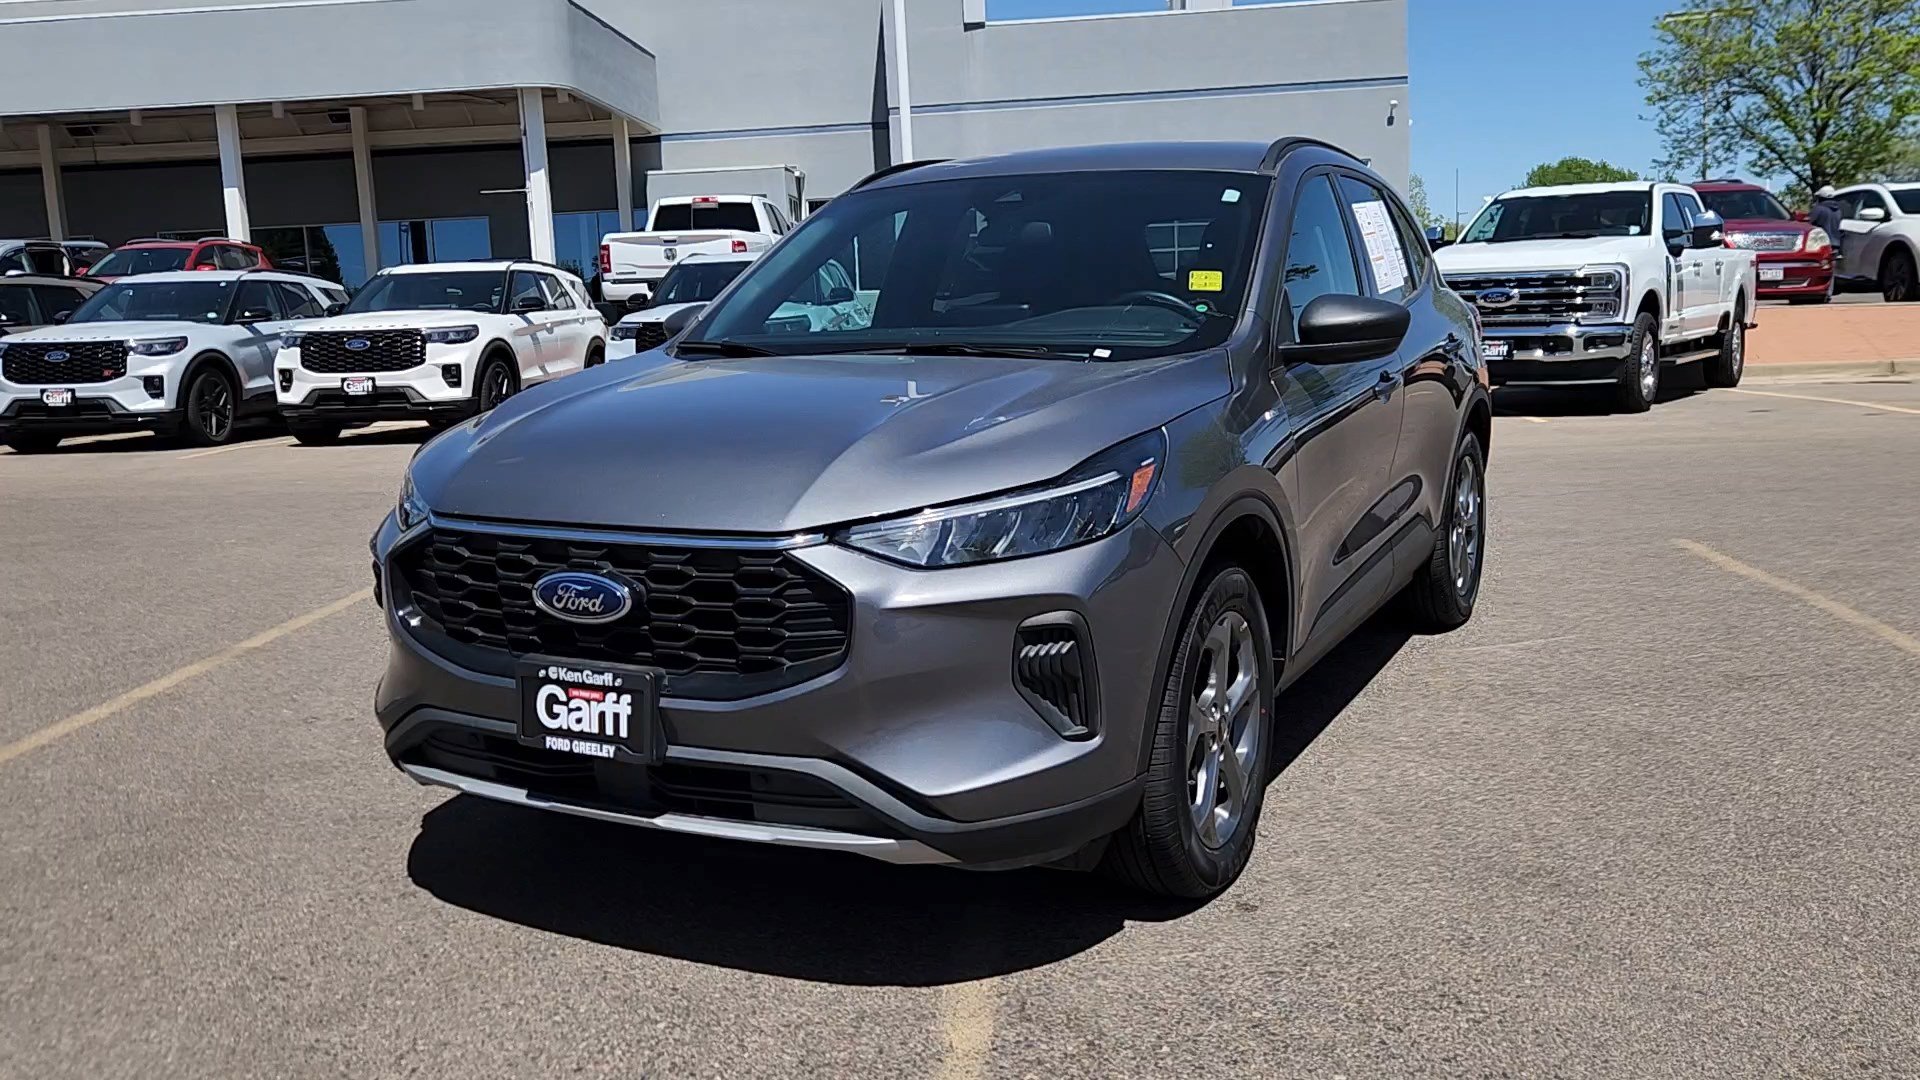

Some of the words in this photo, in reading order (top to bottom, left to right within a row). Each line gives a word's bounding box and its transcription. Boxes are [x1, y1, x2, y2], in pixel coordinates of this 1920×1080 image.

[343, 379, 373, 393] Garff
[42, 391, 72, 404] Garff
[553, 582, 605, 613] Ford
[558, 666, 582, 683] Ken
[582, 669, 613, 687] Garff
[536, 684, 632, 738] Garff
[545, 736, 571, 752] FORD
[571, 740, 616, 758] GREELEY
